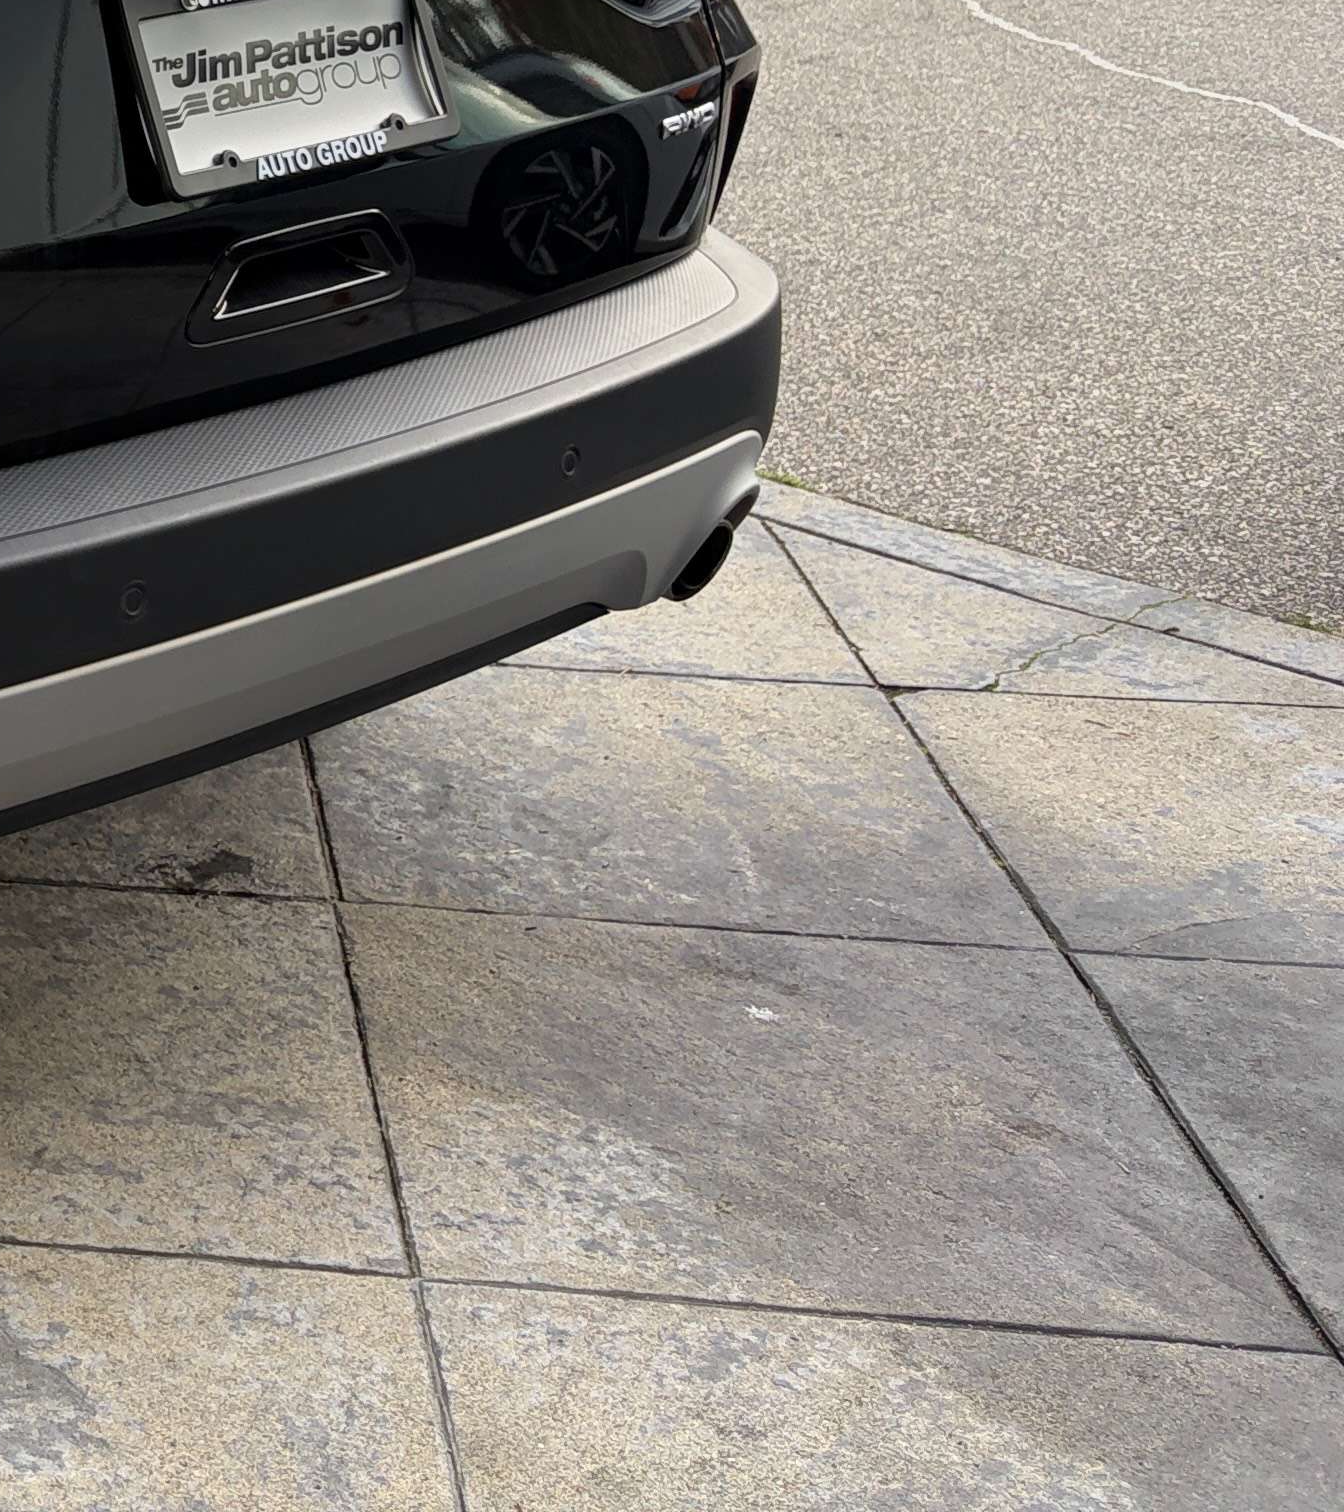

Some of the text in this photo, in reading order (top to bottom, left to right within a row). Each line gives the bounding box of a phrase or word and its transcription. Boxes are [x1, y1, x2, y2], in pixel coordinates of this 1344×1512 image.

[152, 21, 404, 88] The Jim Pattison
[662, 101, 716, 135] AWD
[257, 131, 388, 181] AUTO GROUP
